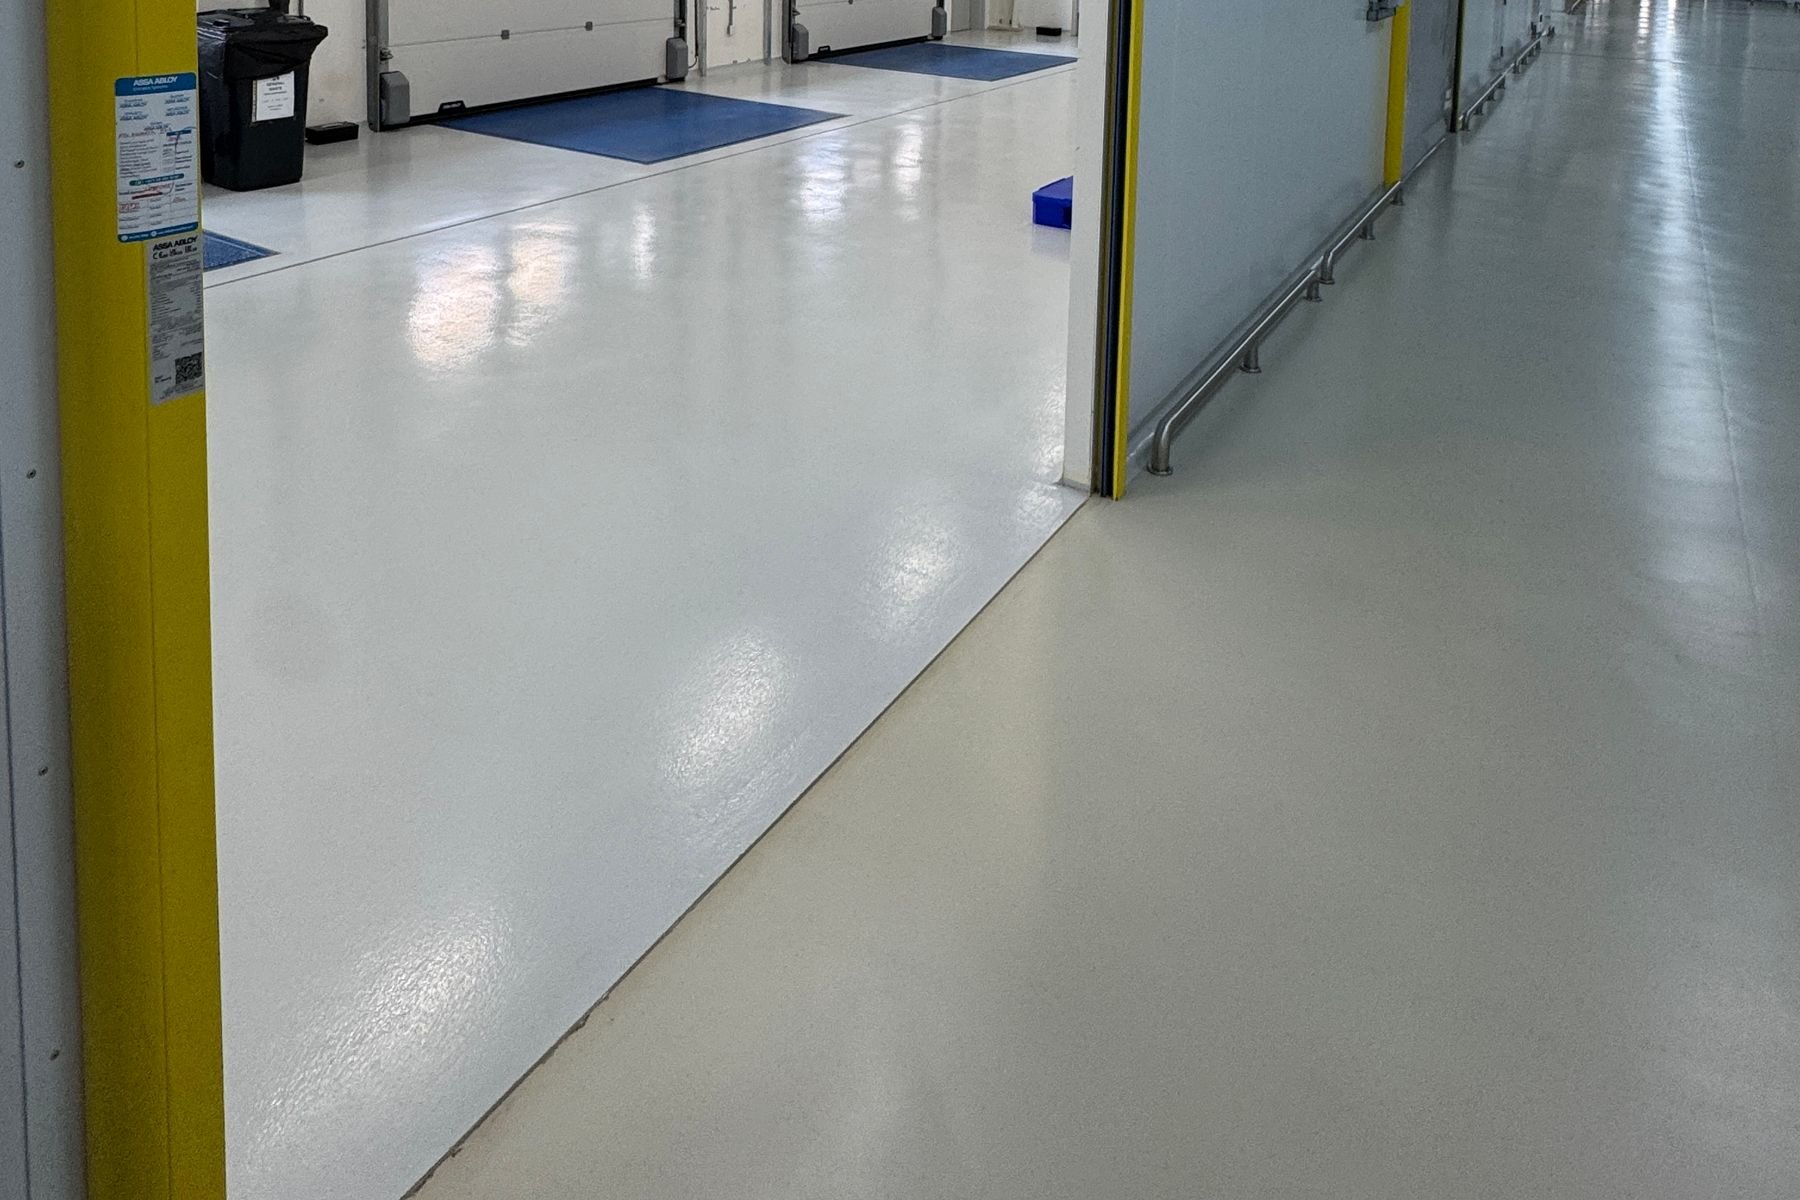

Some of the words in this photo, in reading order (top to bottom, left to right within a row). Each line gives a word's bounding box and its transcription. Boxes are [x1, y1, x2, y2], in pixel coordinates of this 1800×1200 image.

[133, 78, 154, 87] ASSA
[154, 76, 178, 85] ABLOY
[153, 242, 173, 251] ASSA
[174, 236, 198, 247] ABLOY
